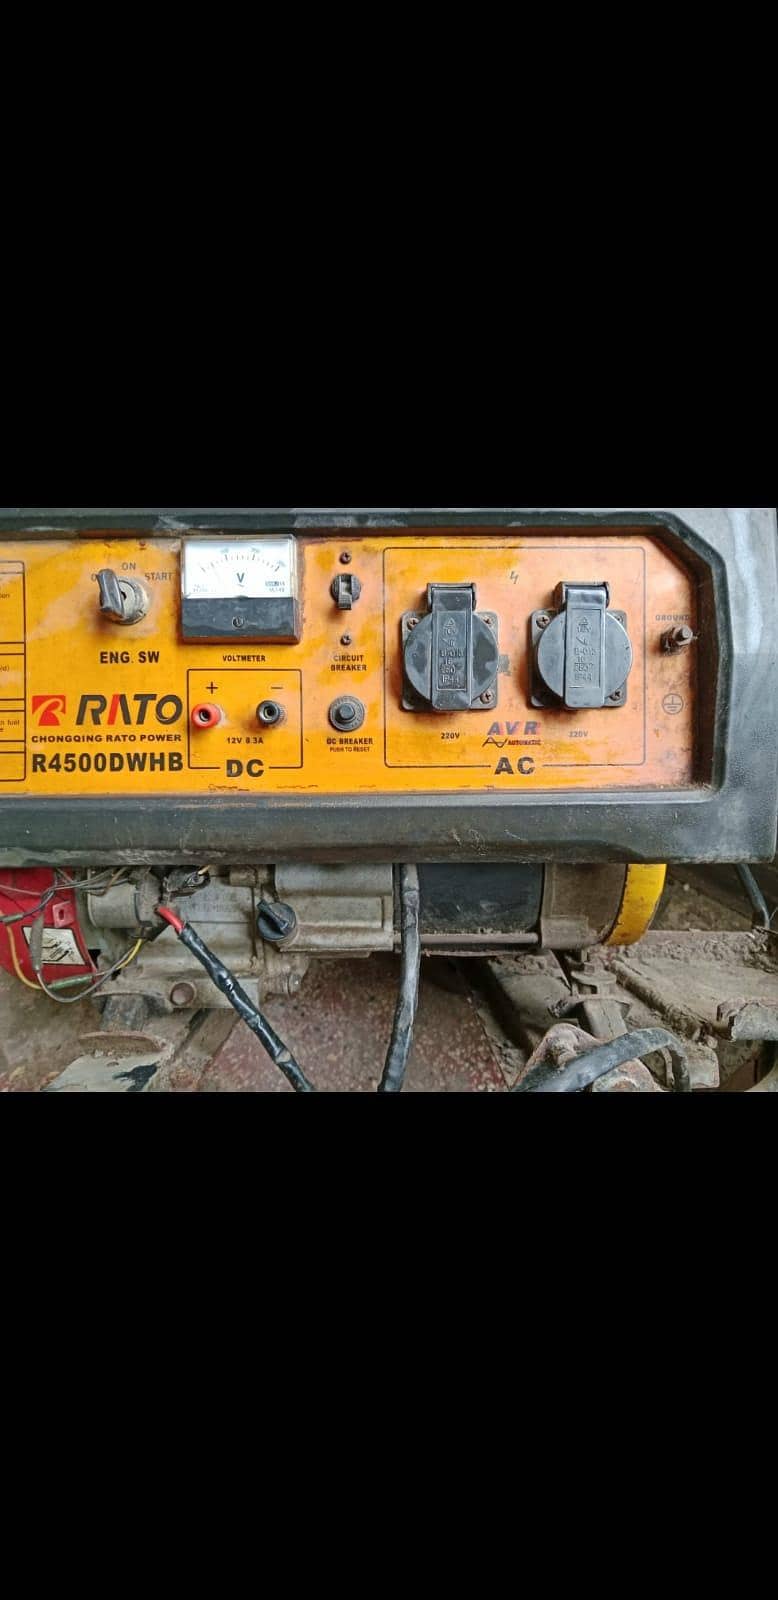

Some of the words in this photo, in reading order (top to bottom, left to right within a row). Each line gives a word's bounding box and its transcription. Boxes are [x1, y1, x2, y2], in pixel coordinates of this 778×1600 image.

[121, 562, 136, 571] ON
[144, 572, 173, 581] START
[236, 572, 245, 583] V
[138, 651, 161, 664] SW
[222, 654, 266, 662] VOLTMETER
[333, 654, 364, 662] CIRCUIT
[76, 694, 183, 726] RATO
[487, 721, 541, 736] AVR
[31, 735, 105, 743] CHONGQING
[106, 735, 136, 743] RATO
[140, 734, 182, 742] POWER
[338, 737, 373, 745] BREAKER
[440, 732, 460, 740] 220V
[31, 752, 184, 773] R4500DWHB
[494, 757, 535, 775] AC
[226, 759, 264, 777] DC
